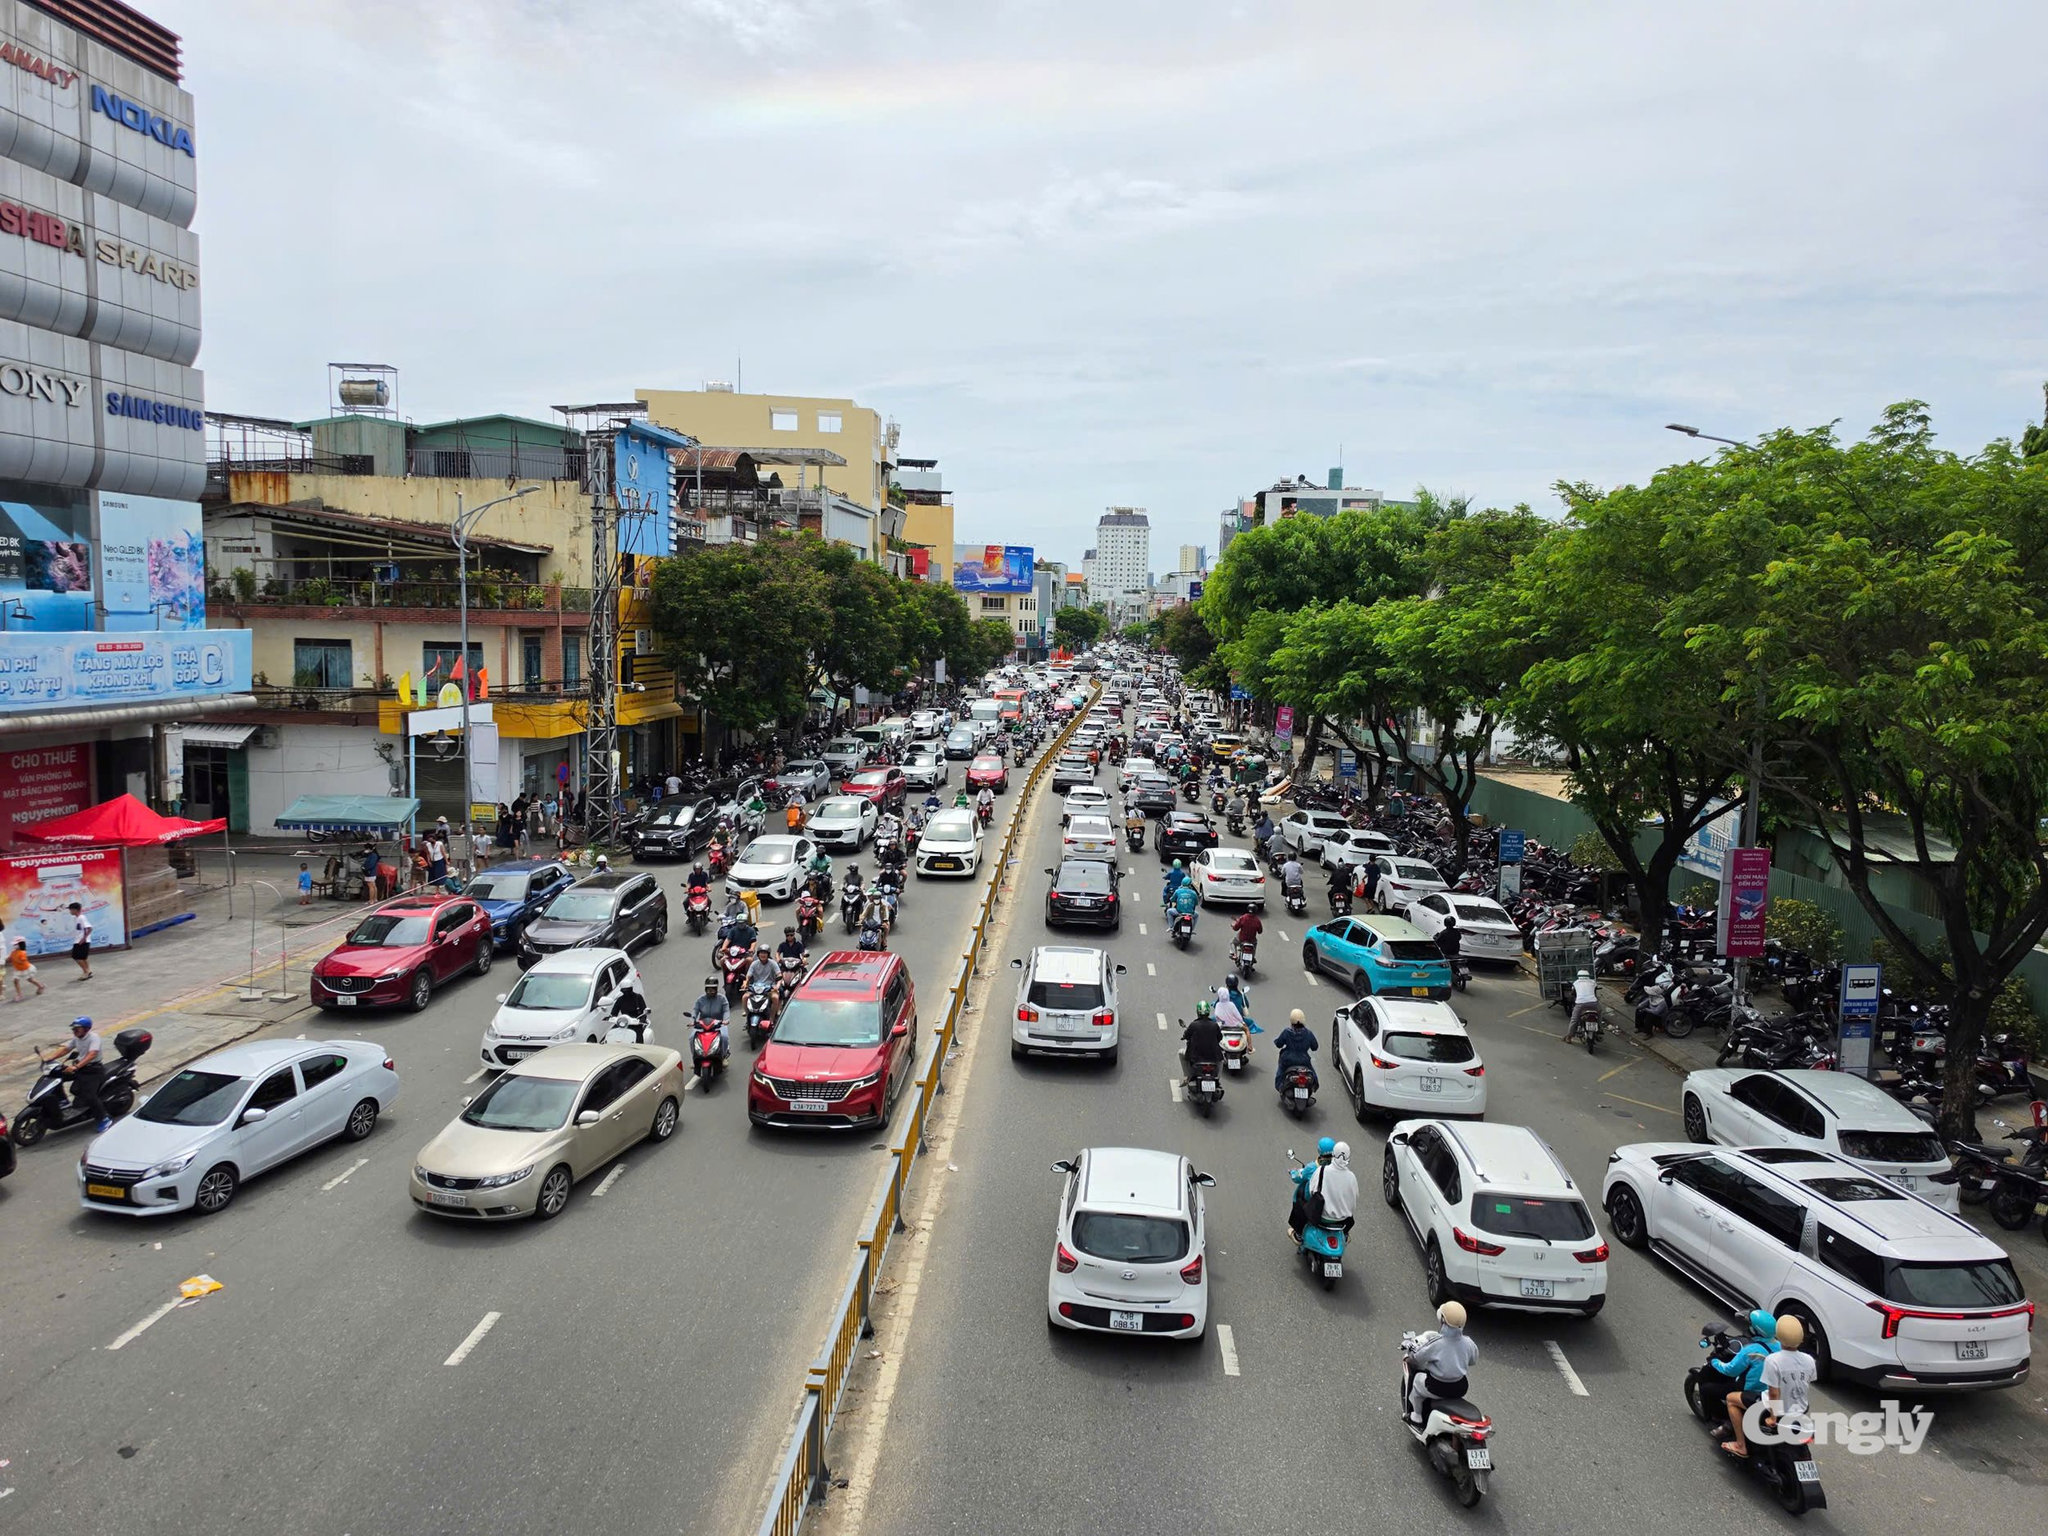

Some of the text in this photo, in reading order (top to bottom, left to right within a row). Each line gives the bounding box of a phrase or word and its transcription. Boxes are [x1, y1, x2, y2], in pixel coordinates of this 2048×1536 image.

[91, 84, 195, 158] NOKIA
[0, 201, 86, 258] SHIBA
[96, 239, 199, 290] SHARP
[0, 364, 87, 407] ONY
[107, 392, 203, 431] SAMSUNG
[103, 544, 118, 553] Neo
[11, 748, 77, 769] CHO THUÊ
[1525, 1287, 1551, 1296] 321.72
[1530, 1280, 1545, 1288] 43B
[1113, 1319, 1139, 1329] 088.51
[1119, 1312, 1134, 1320] 43B
